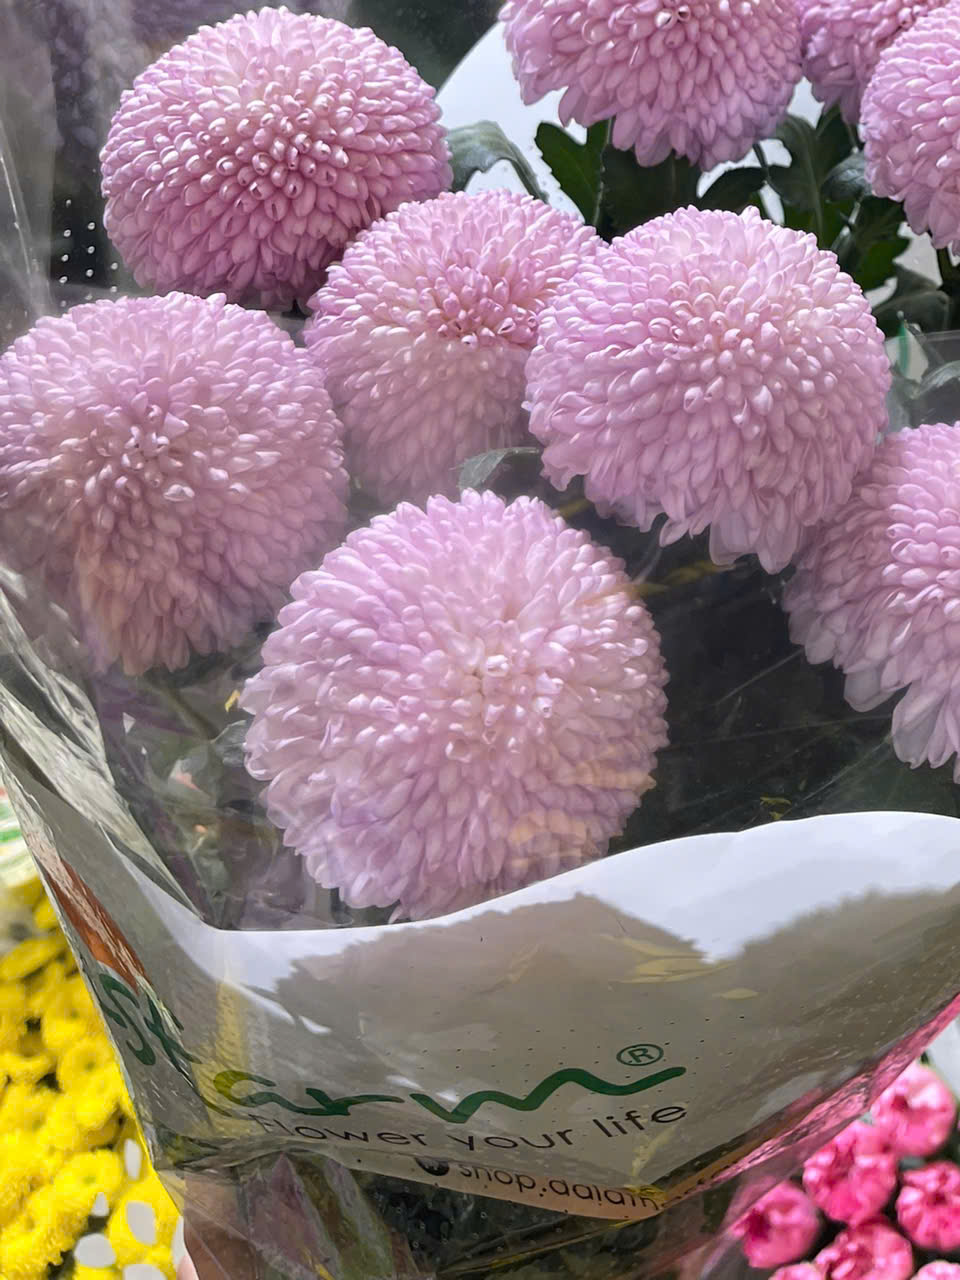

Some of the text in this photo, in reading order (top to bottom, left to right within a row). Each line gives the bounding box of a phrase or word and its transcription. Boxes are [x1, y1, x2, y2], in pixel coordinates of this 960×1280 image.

[248, 1102, 687, 1151] Flower your life
